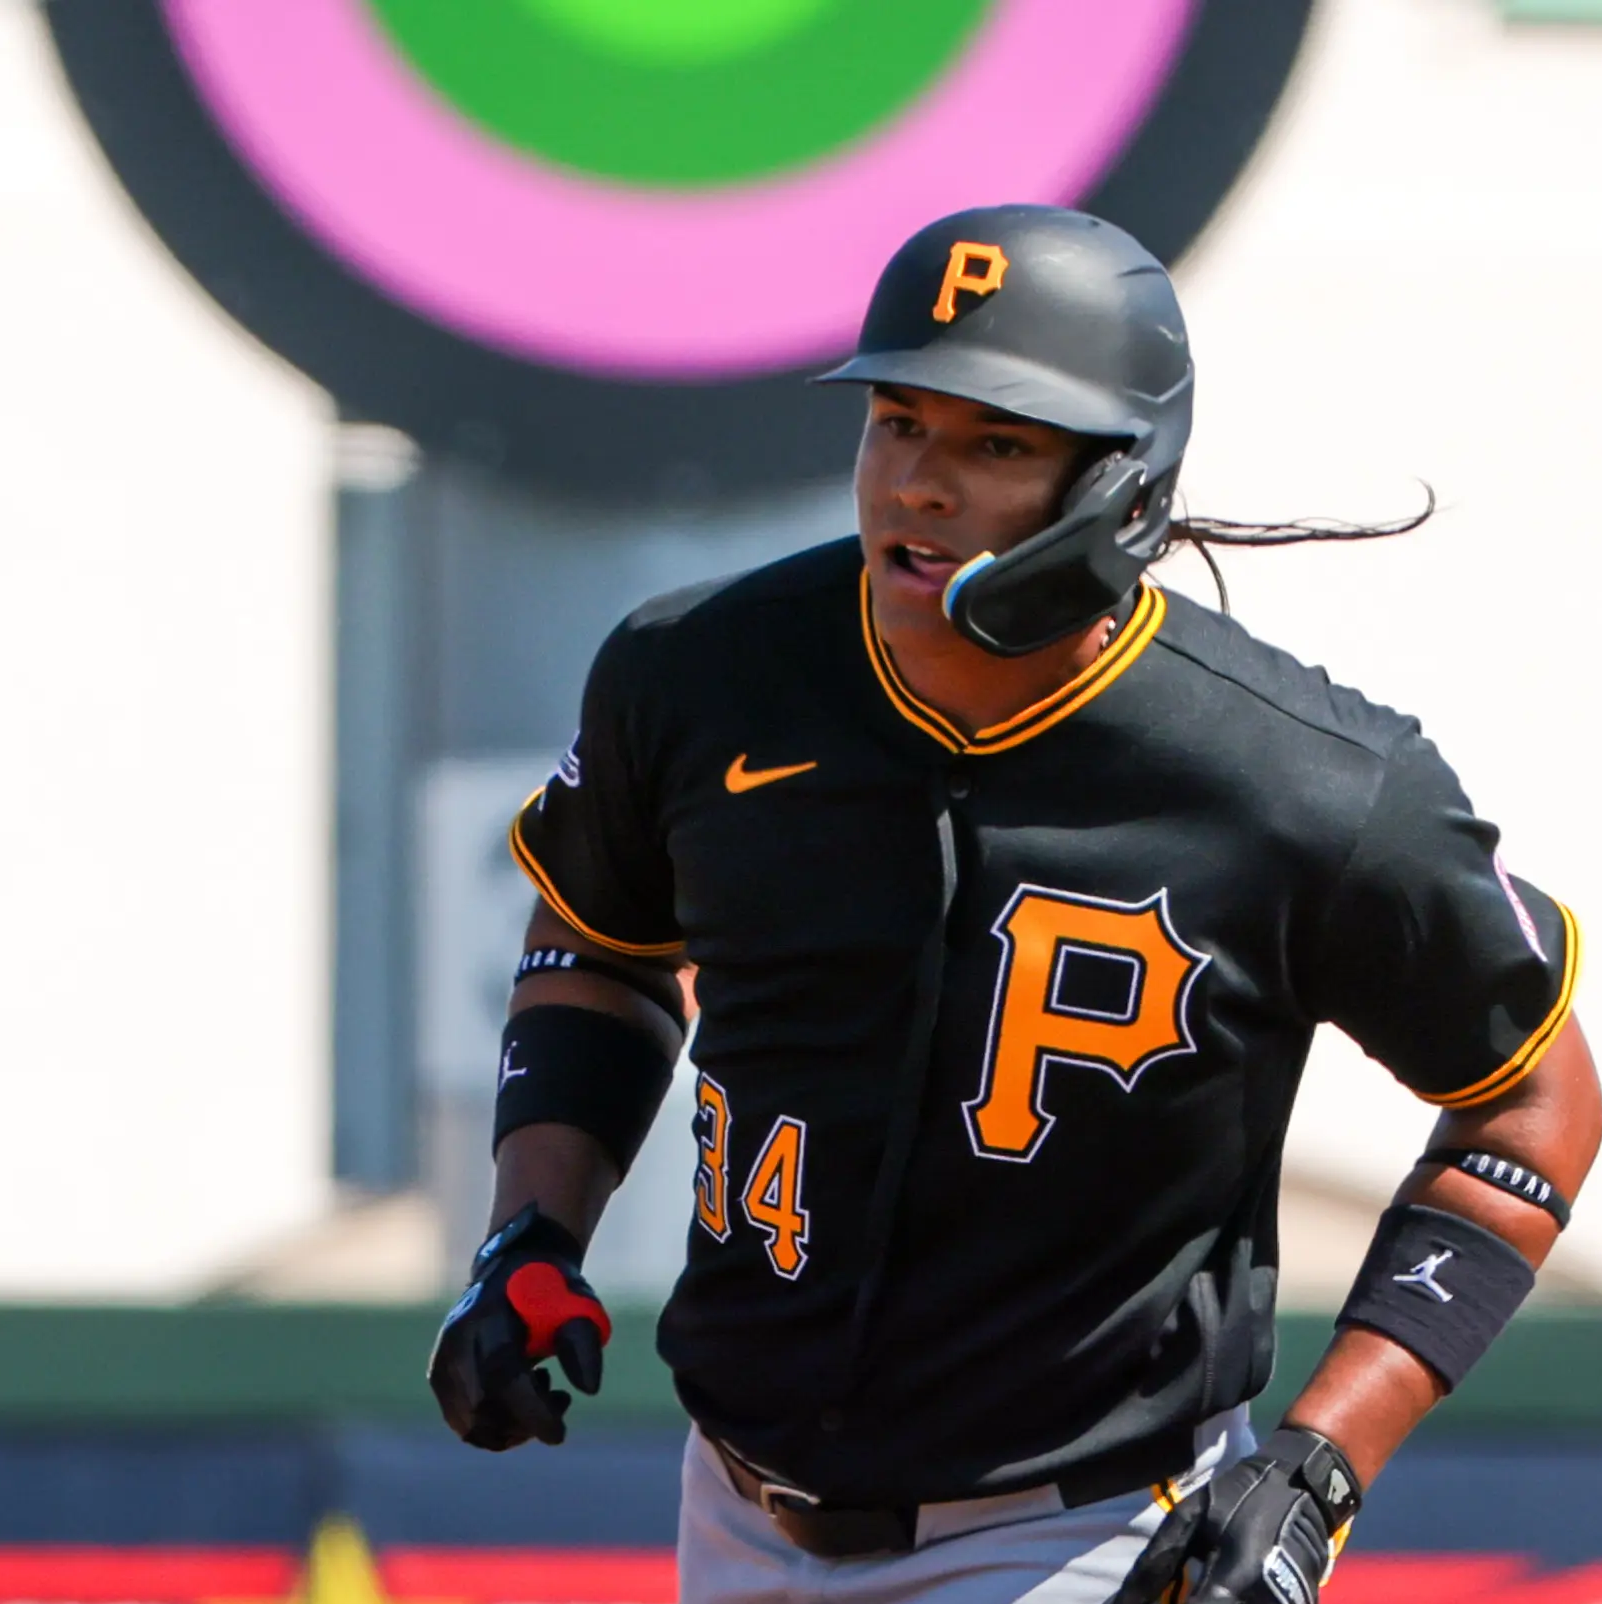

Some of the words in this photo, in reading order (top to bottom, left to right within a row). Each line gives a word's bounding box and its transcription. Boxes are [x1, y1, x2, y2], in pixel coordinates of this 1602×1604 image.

[933, 241, 1008, 323] P
[963, 884, 1212, 1162] P
[696, 1072, 810, 1280] 34
[1460, 1152, 1553, 1204] JORDAN
